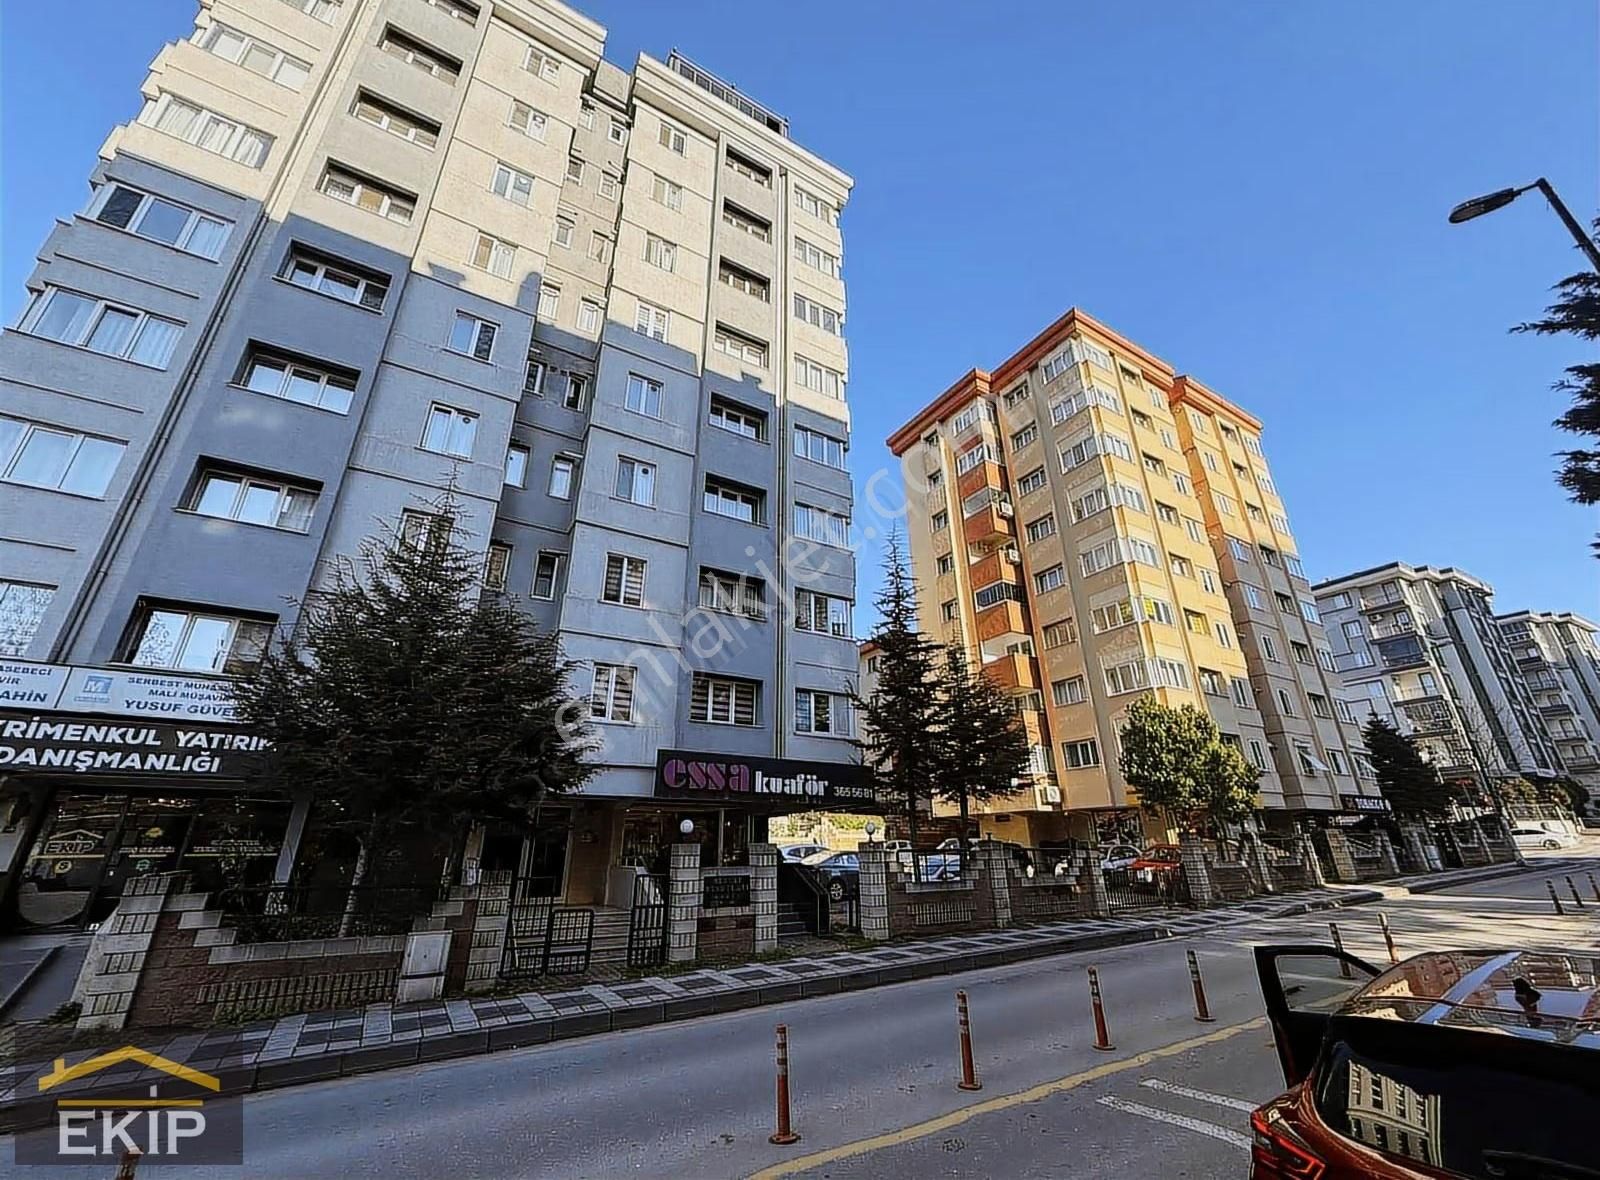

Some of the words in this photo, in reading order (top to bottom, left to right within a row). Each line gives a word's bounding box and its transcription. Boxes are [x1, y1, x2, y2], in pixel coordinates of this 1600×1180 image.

[125, 700, 182, 713] YUSUF
[187, 704, 246, 717] GÜVE
[0, 716, 161, 746] RİMENKUL
[0, 746, 220, 772] DANIŞMANLIĞI
[663, 759, 750, 792] essa
[755, 771, 829, 796] kuaför
